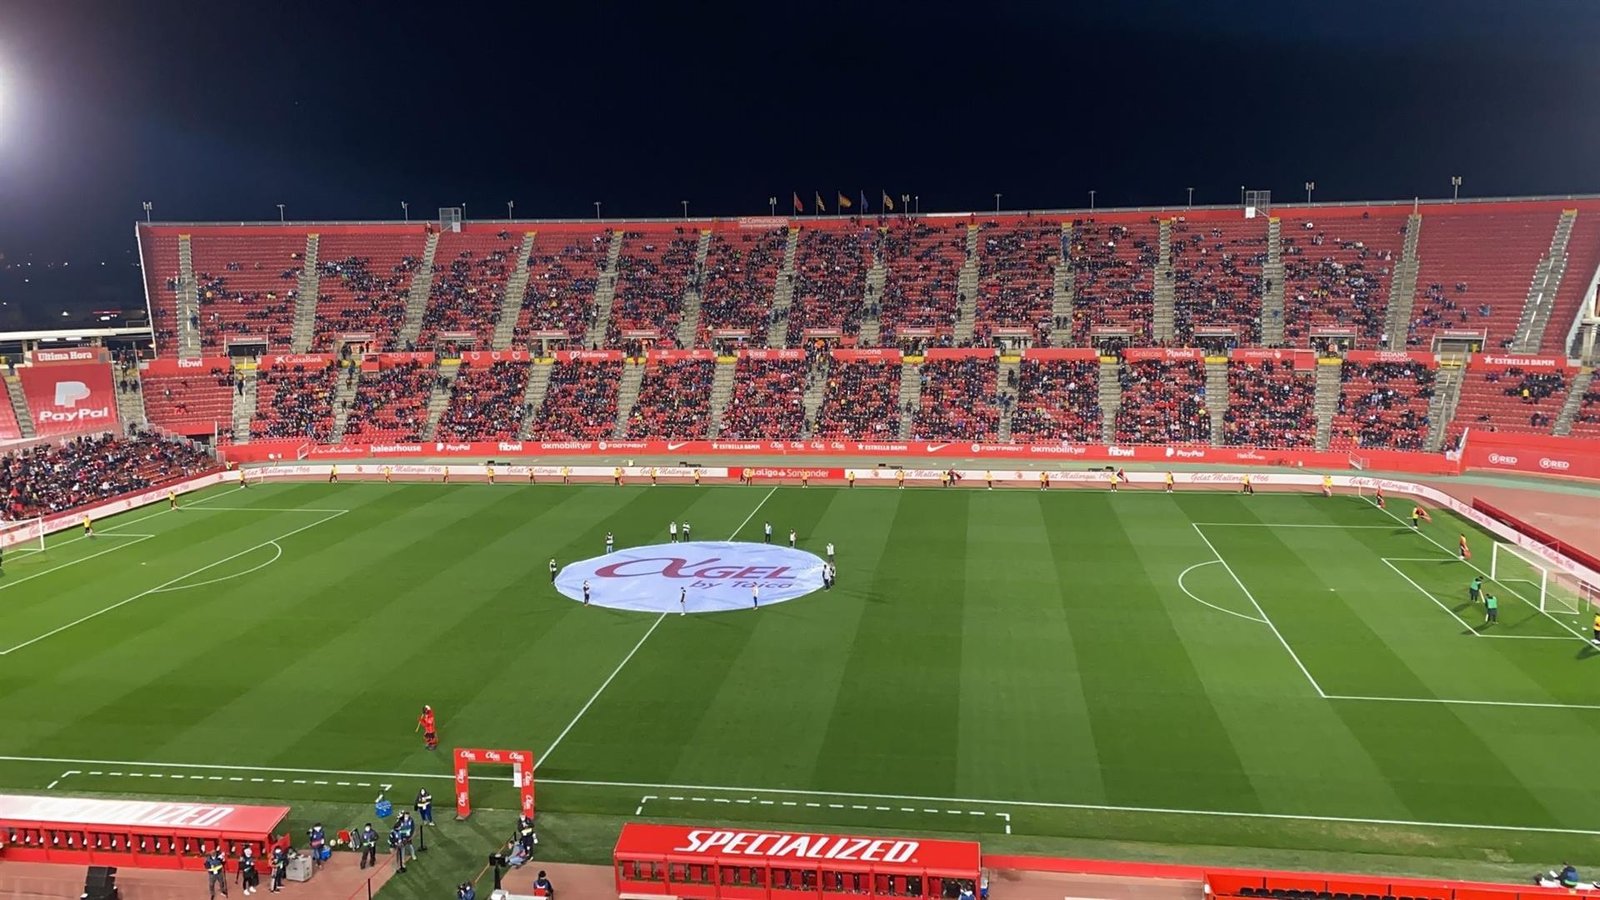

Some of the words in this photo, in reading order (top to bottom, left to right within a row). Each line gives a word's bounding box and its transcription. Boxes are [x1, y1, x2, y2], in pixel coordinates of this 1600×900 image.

[37, 351, 69, 362] Ultima
[70, 350, 93, 360] Hora
[285, 354, 322, 363] CaixaBank
[178, 358, 203, 368] fibwi
[1494, 358, 1530, 366] ESTRELLA
[1531, 359, 1555, 367] DAMM
[39, 407, 109, 422] PayPal
[370, 444, 422, 453] balearhouse
[446, 444, 470, 452] PayPal
[498, 442, 522, 451] fibwi
[1108, 446, 1135, 457] fibwi
[1176, 450, 1205, 458] PayPal
[689, 581, 723, 590] by
[674, 829, 920, 864] SPECIALIZED
